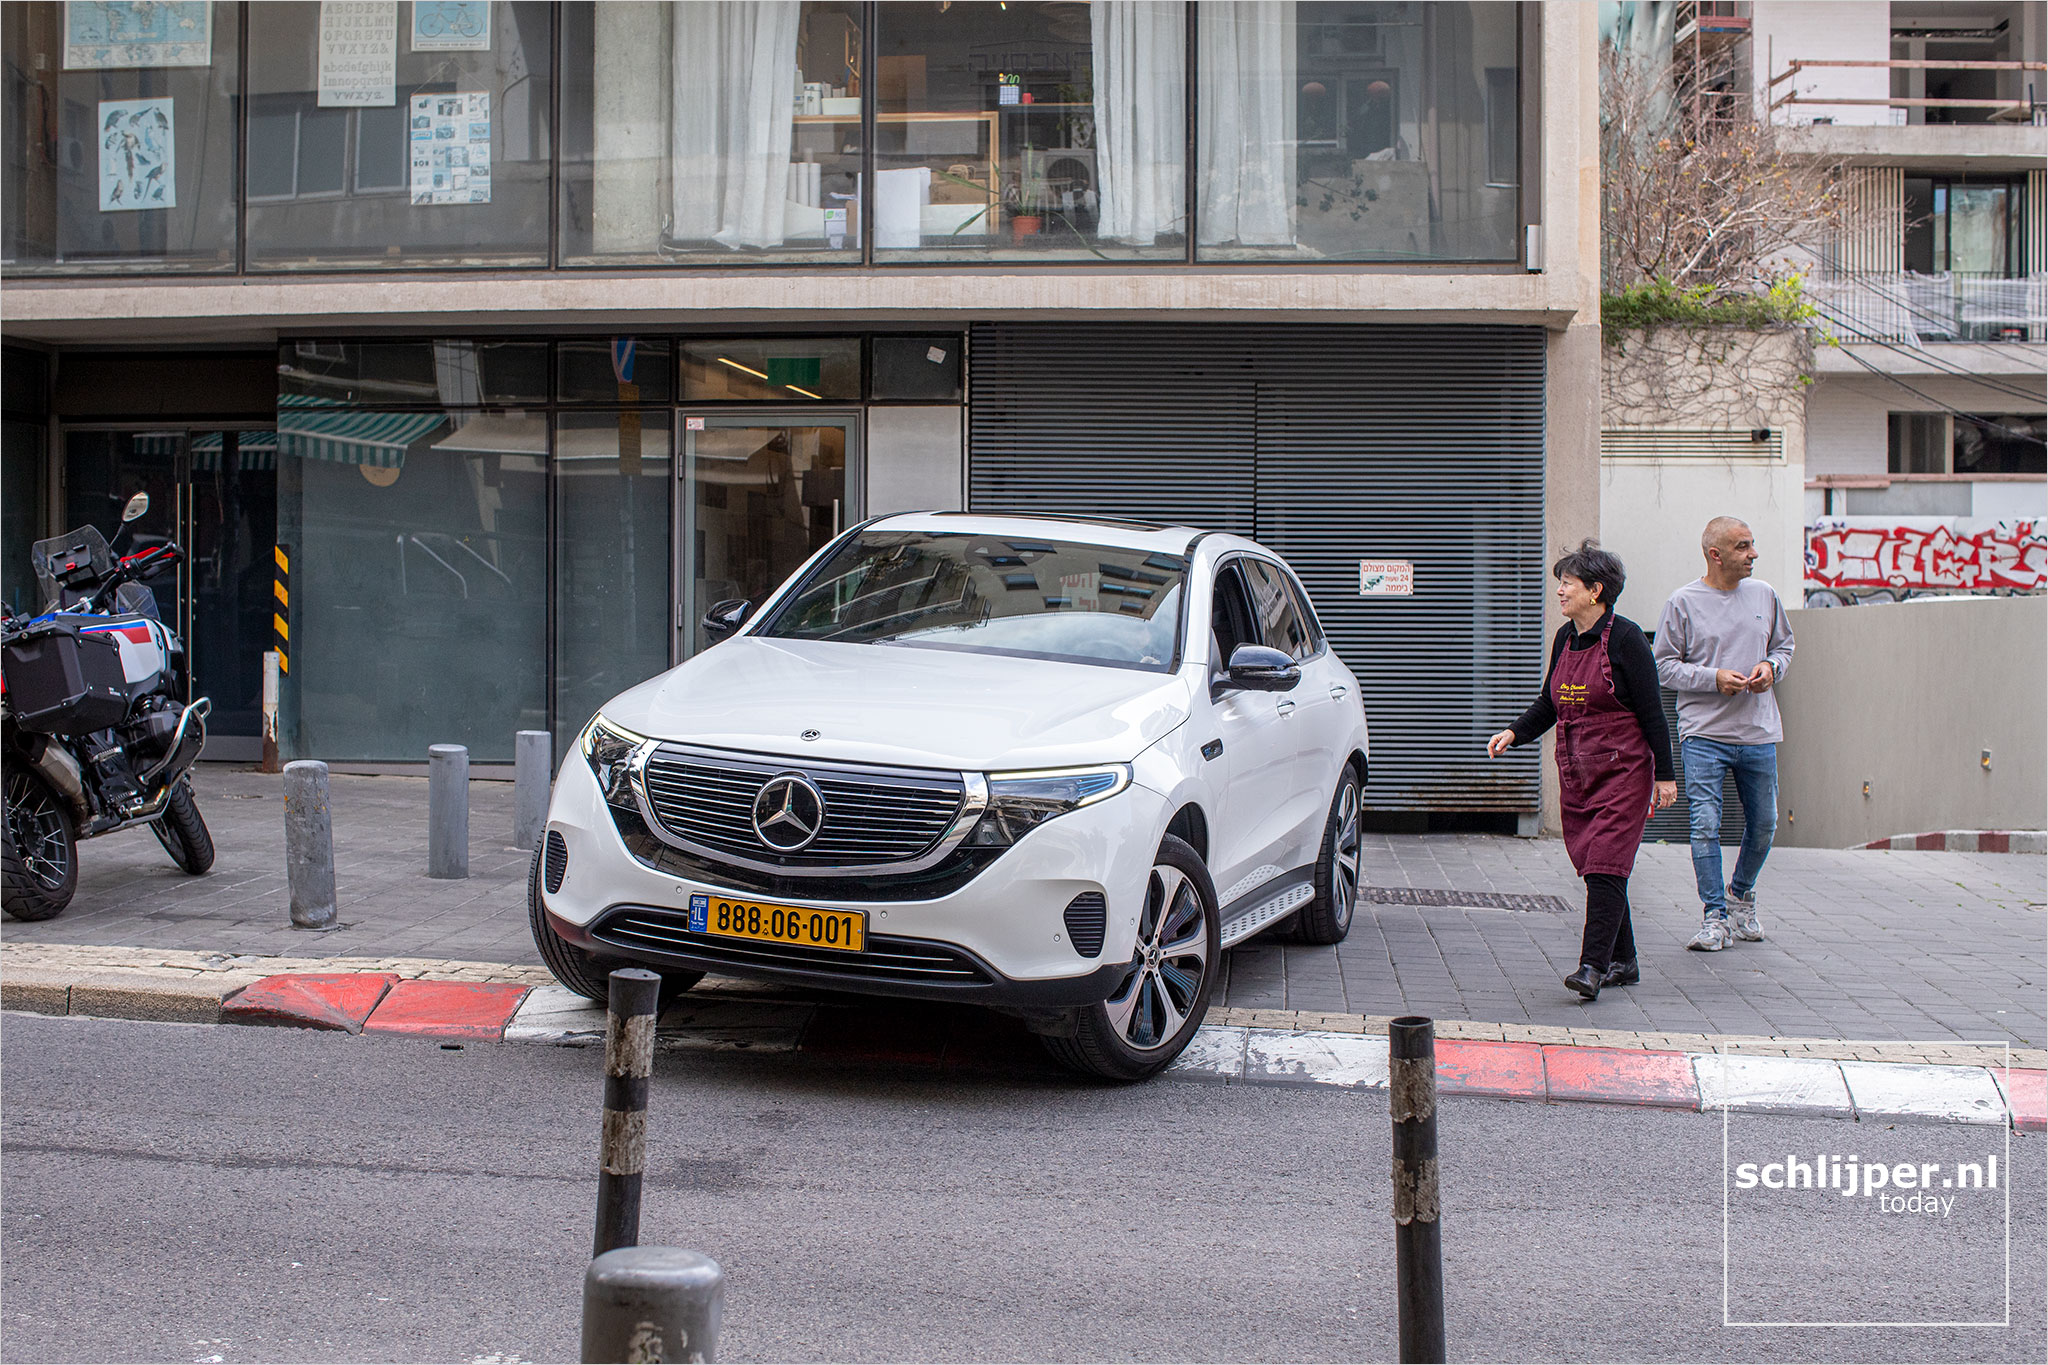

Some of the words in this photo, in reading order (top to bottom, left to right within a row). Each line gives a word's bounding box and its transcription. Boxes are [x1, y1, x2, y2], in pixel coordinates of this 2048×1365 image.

[1363, 563, 1385, 572] מצולם
[1386, 564, 1410, 574] המקום
[1400, 574, 1409, 582] 24
[693, 906, 704, 921] IL
